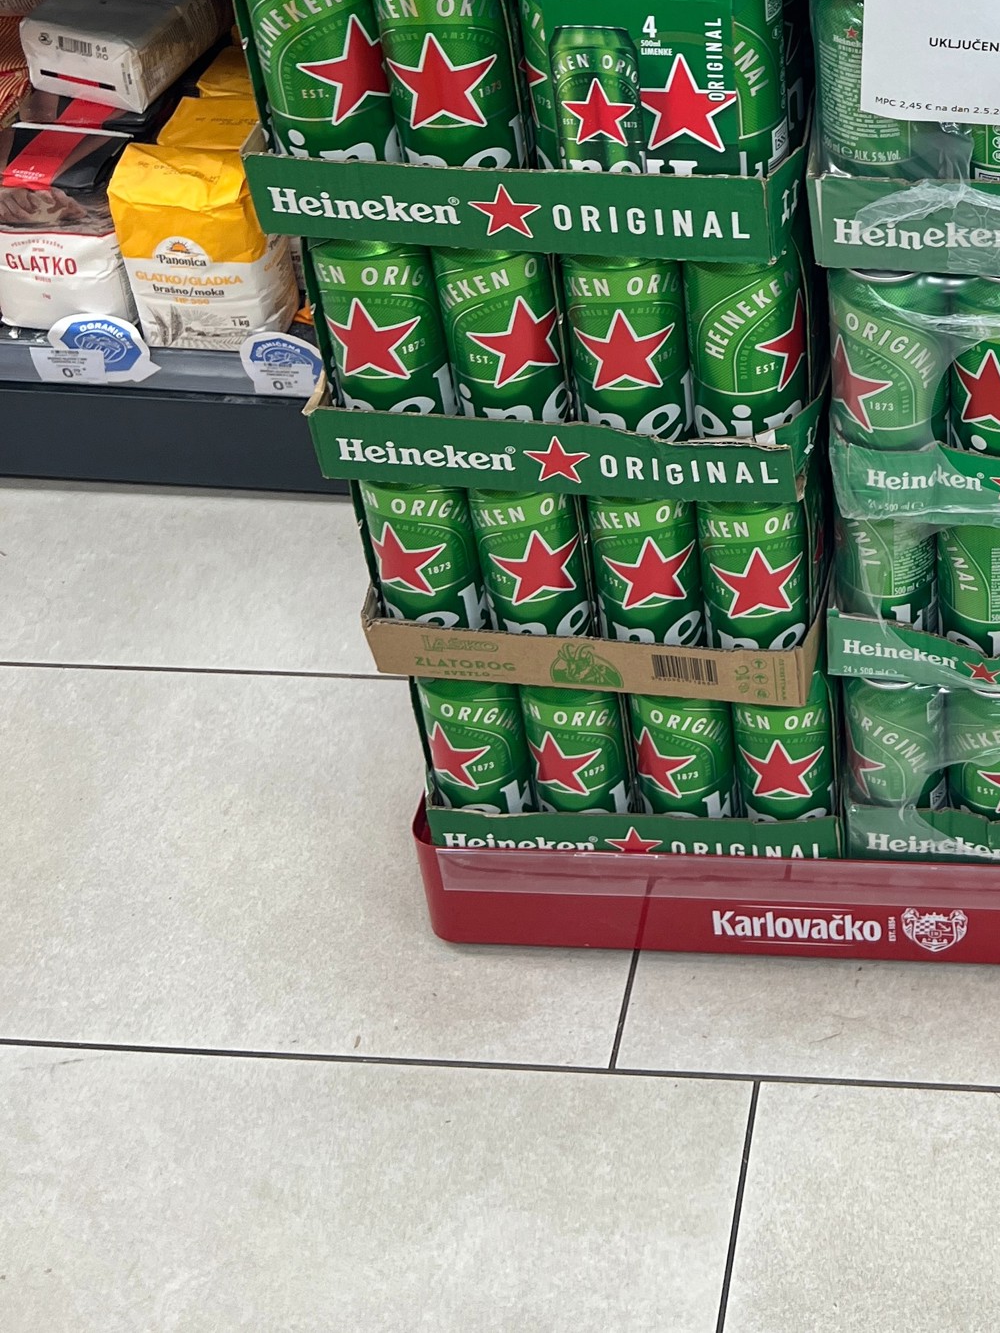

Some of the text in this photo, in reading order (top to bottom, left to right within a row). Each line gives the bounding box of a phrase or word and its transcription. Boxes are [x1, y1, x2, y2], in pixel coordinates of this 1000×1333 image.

[875, 95, 897, 108] MPC
[899, 99, 922, 112] 2,45
[925, 102, 933, 111] €
[935, 105, 948, 113] na
[951, 103, 970, 114] dan
[266, 186, 750, 240] Heineken ORIGINAL
[5, 252, 78, 276] GLATKO
[156, 253, 207, 267] Panonica
[135, 270, 243, 286] GLATKO/GLADKA
[152, 283, 225, 297] brašno/moka
[844, 311, 935, 390] ORIGINAL
[334, 438, 779, 485] Heineken ORIGINAL
[866, 467, 982, 493] Heineken
[414, 655, 517, 672] ZLATOROG
[842, 638, 957, 670] Heineken
[443, 670, 491, 678] SVETLO
[711, 910, 882, 943] Karlovačko
